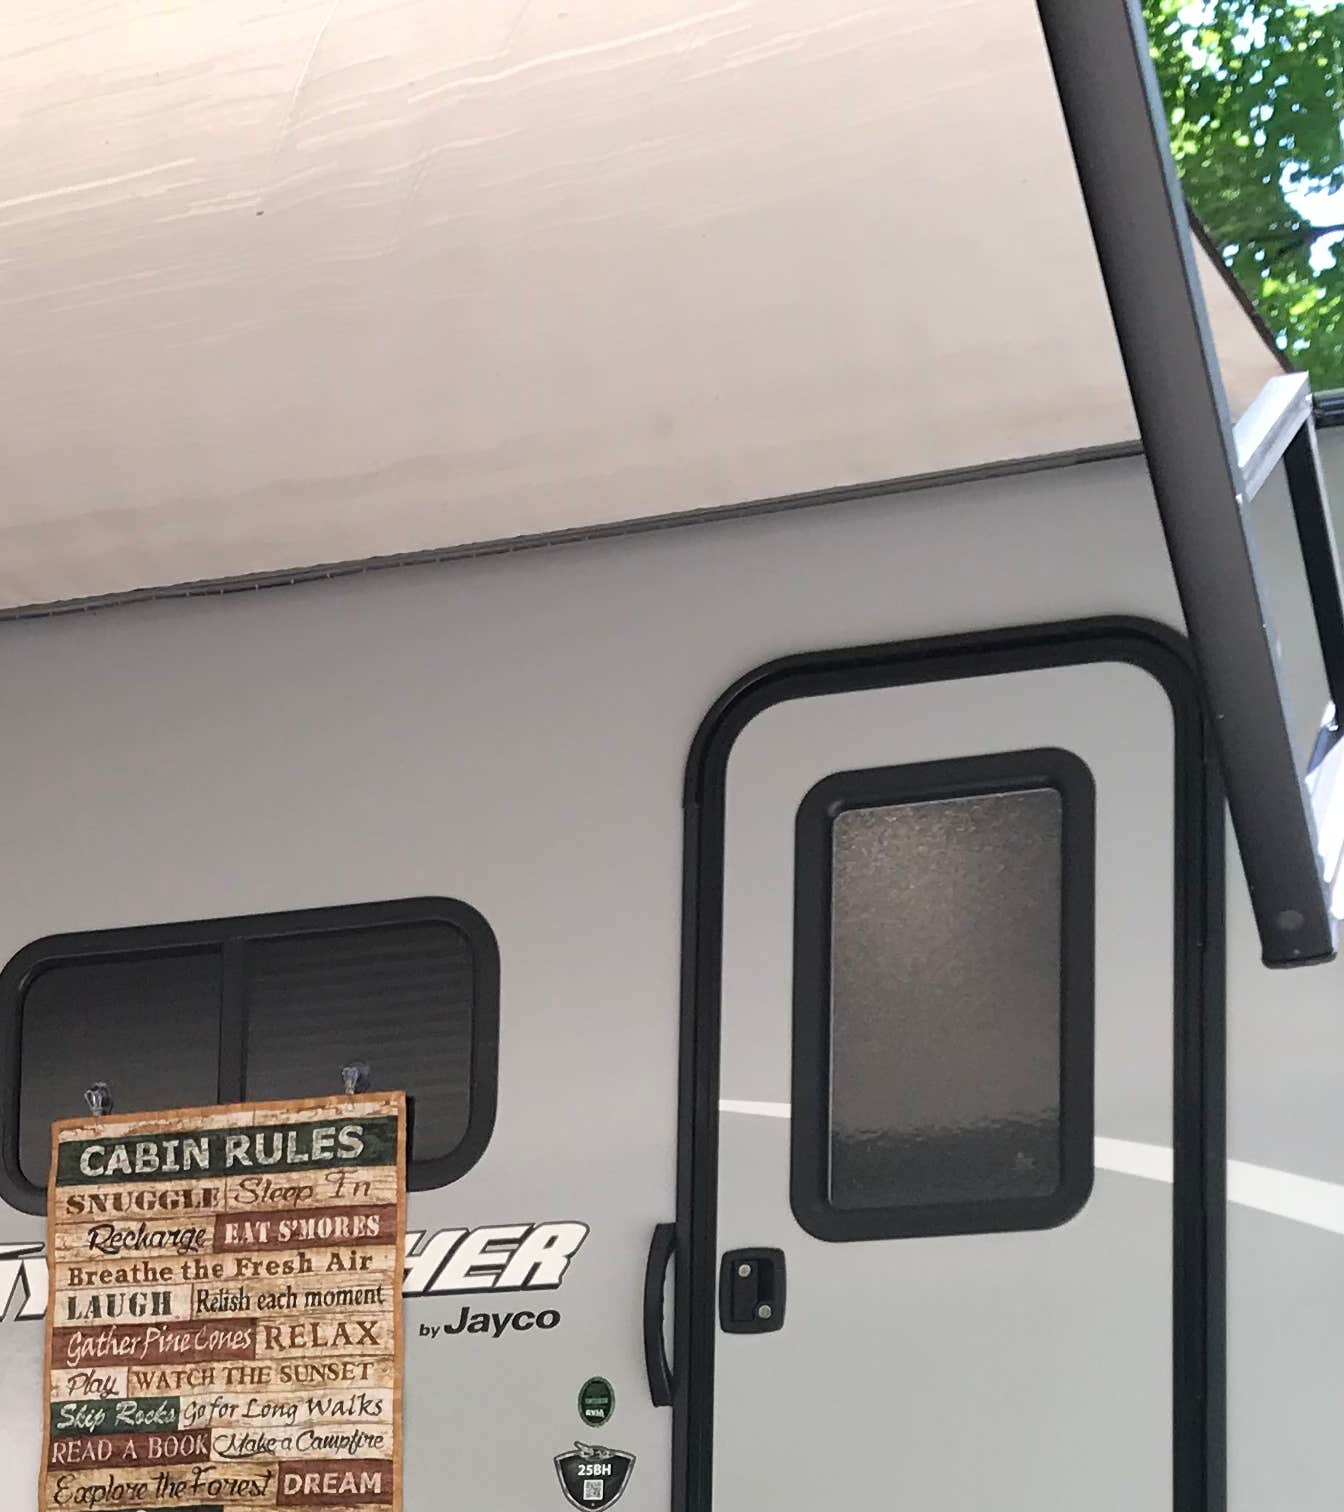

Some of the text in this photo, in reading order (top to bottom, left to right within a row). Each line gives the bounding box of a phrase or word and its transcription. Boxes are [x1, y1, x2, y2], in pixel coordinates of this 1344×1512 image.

[80, 1125, 366, 1178] CABIN RULES
[65, 1187, 220, 1215] SNUGGLE
[234, 1171, 371, 1204] Sleep In
[87, 1222, 206, 1253] Recharge
[224, 1215, 380, 1244] EAT S'MORES
[68, 1252, 373, 1286] Breathe the Fresh Air
[67, 1291, 172, 1320] LAUGH
[196, 1285, 385, 1313] Relish each moment
[264, 1321, 380, 1350] RELAX
[419, 1306, 562, 1339] by Jayco
[67, 1325, 252, 1366] Gather Pine Cones
[67, 1372, 119, 1397] Play
[134, 1362, 374, 1390] WATCH THE SUNSET
[57, 1400, 177, 1429] Skip Rocks
[182, 1392, 384, 1428] Go for Long Walks
[52, 1435, 208, 1464] READ A BOOK
[213, 1433, 274, 1460] Make
[295, 1429, 385, 1455] Campfire
[283, 1471, 382, 1495] DREAM
[577, 1464, 612, 1476] 25BH
[54, 1467, 273, 1505] Explore the Forest
